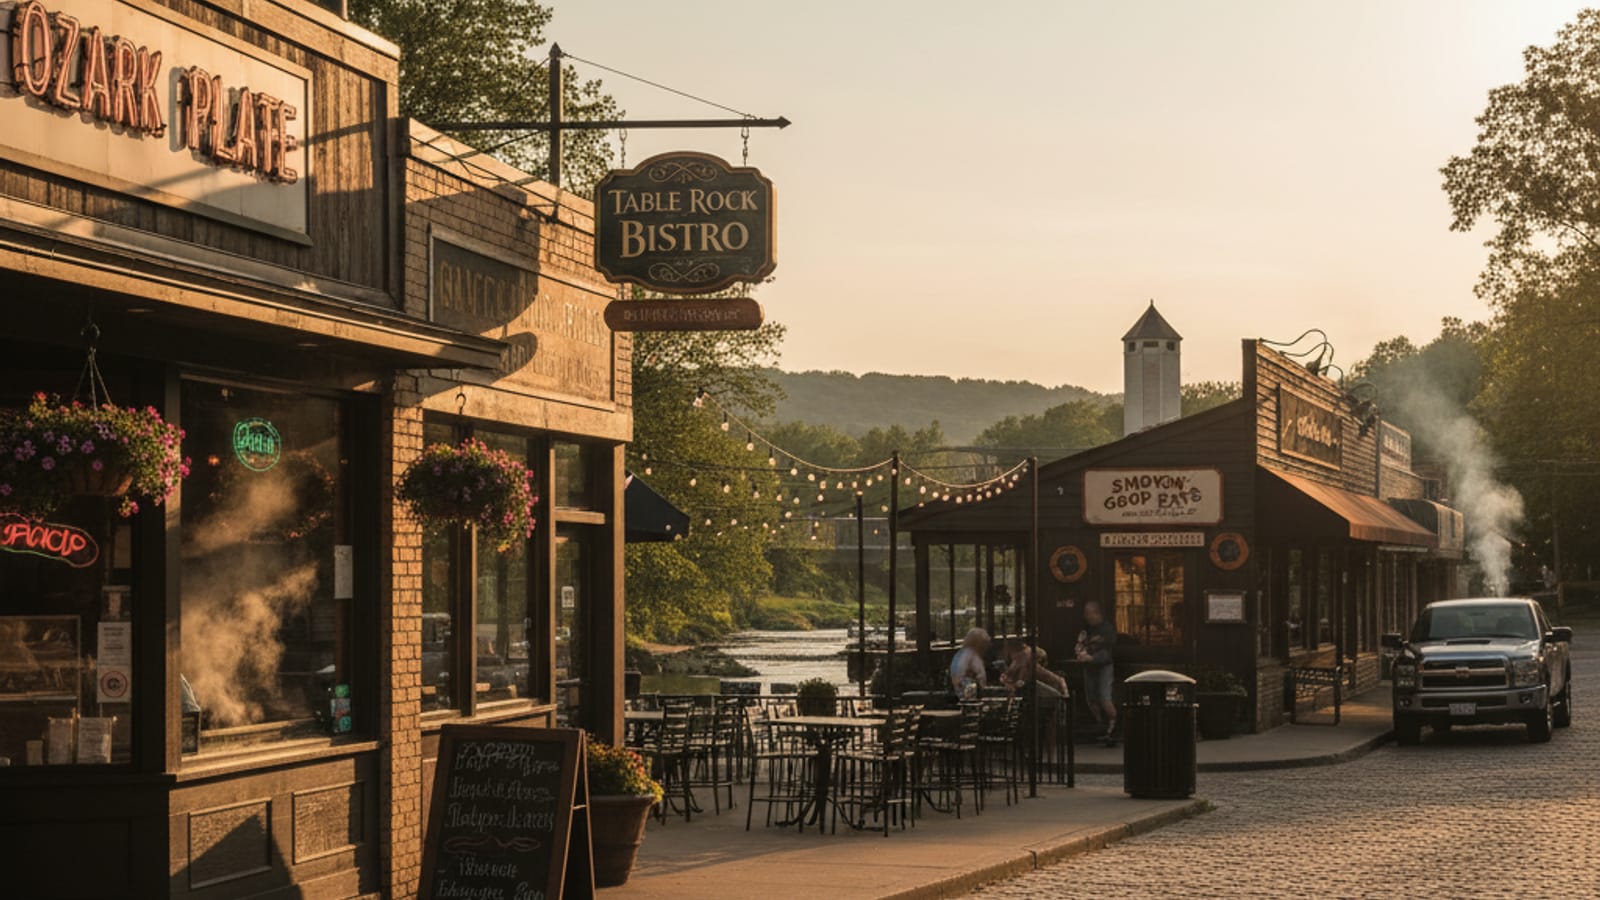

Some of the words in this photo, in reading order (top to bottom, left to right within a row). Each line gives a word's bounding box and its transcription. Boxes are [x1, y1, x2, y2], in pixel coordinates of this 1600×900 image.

[13, 1, 166, 138] OZARK
[179, 65, 298, 184] PLATE
[608, 189, 682, 215] TABLE
[689, 189, 758, 215] ROCK
[619, 220, 749, 258] BISTRO
